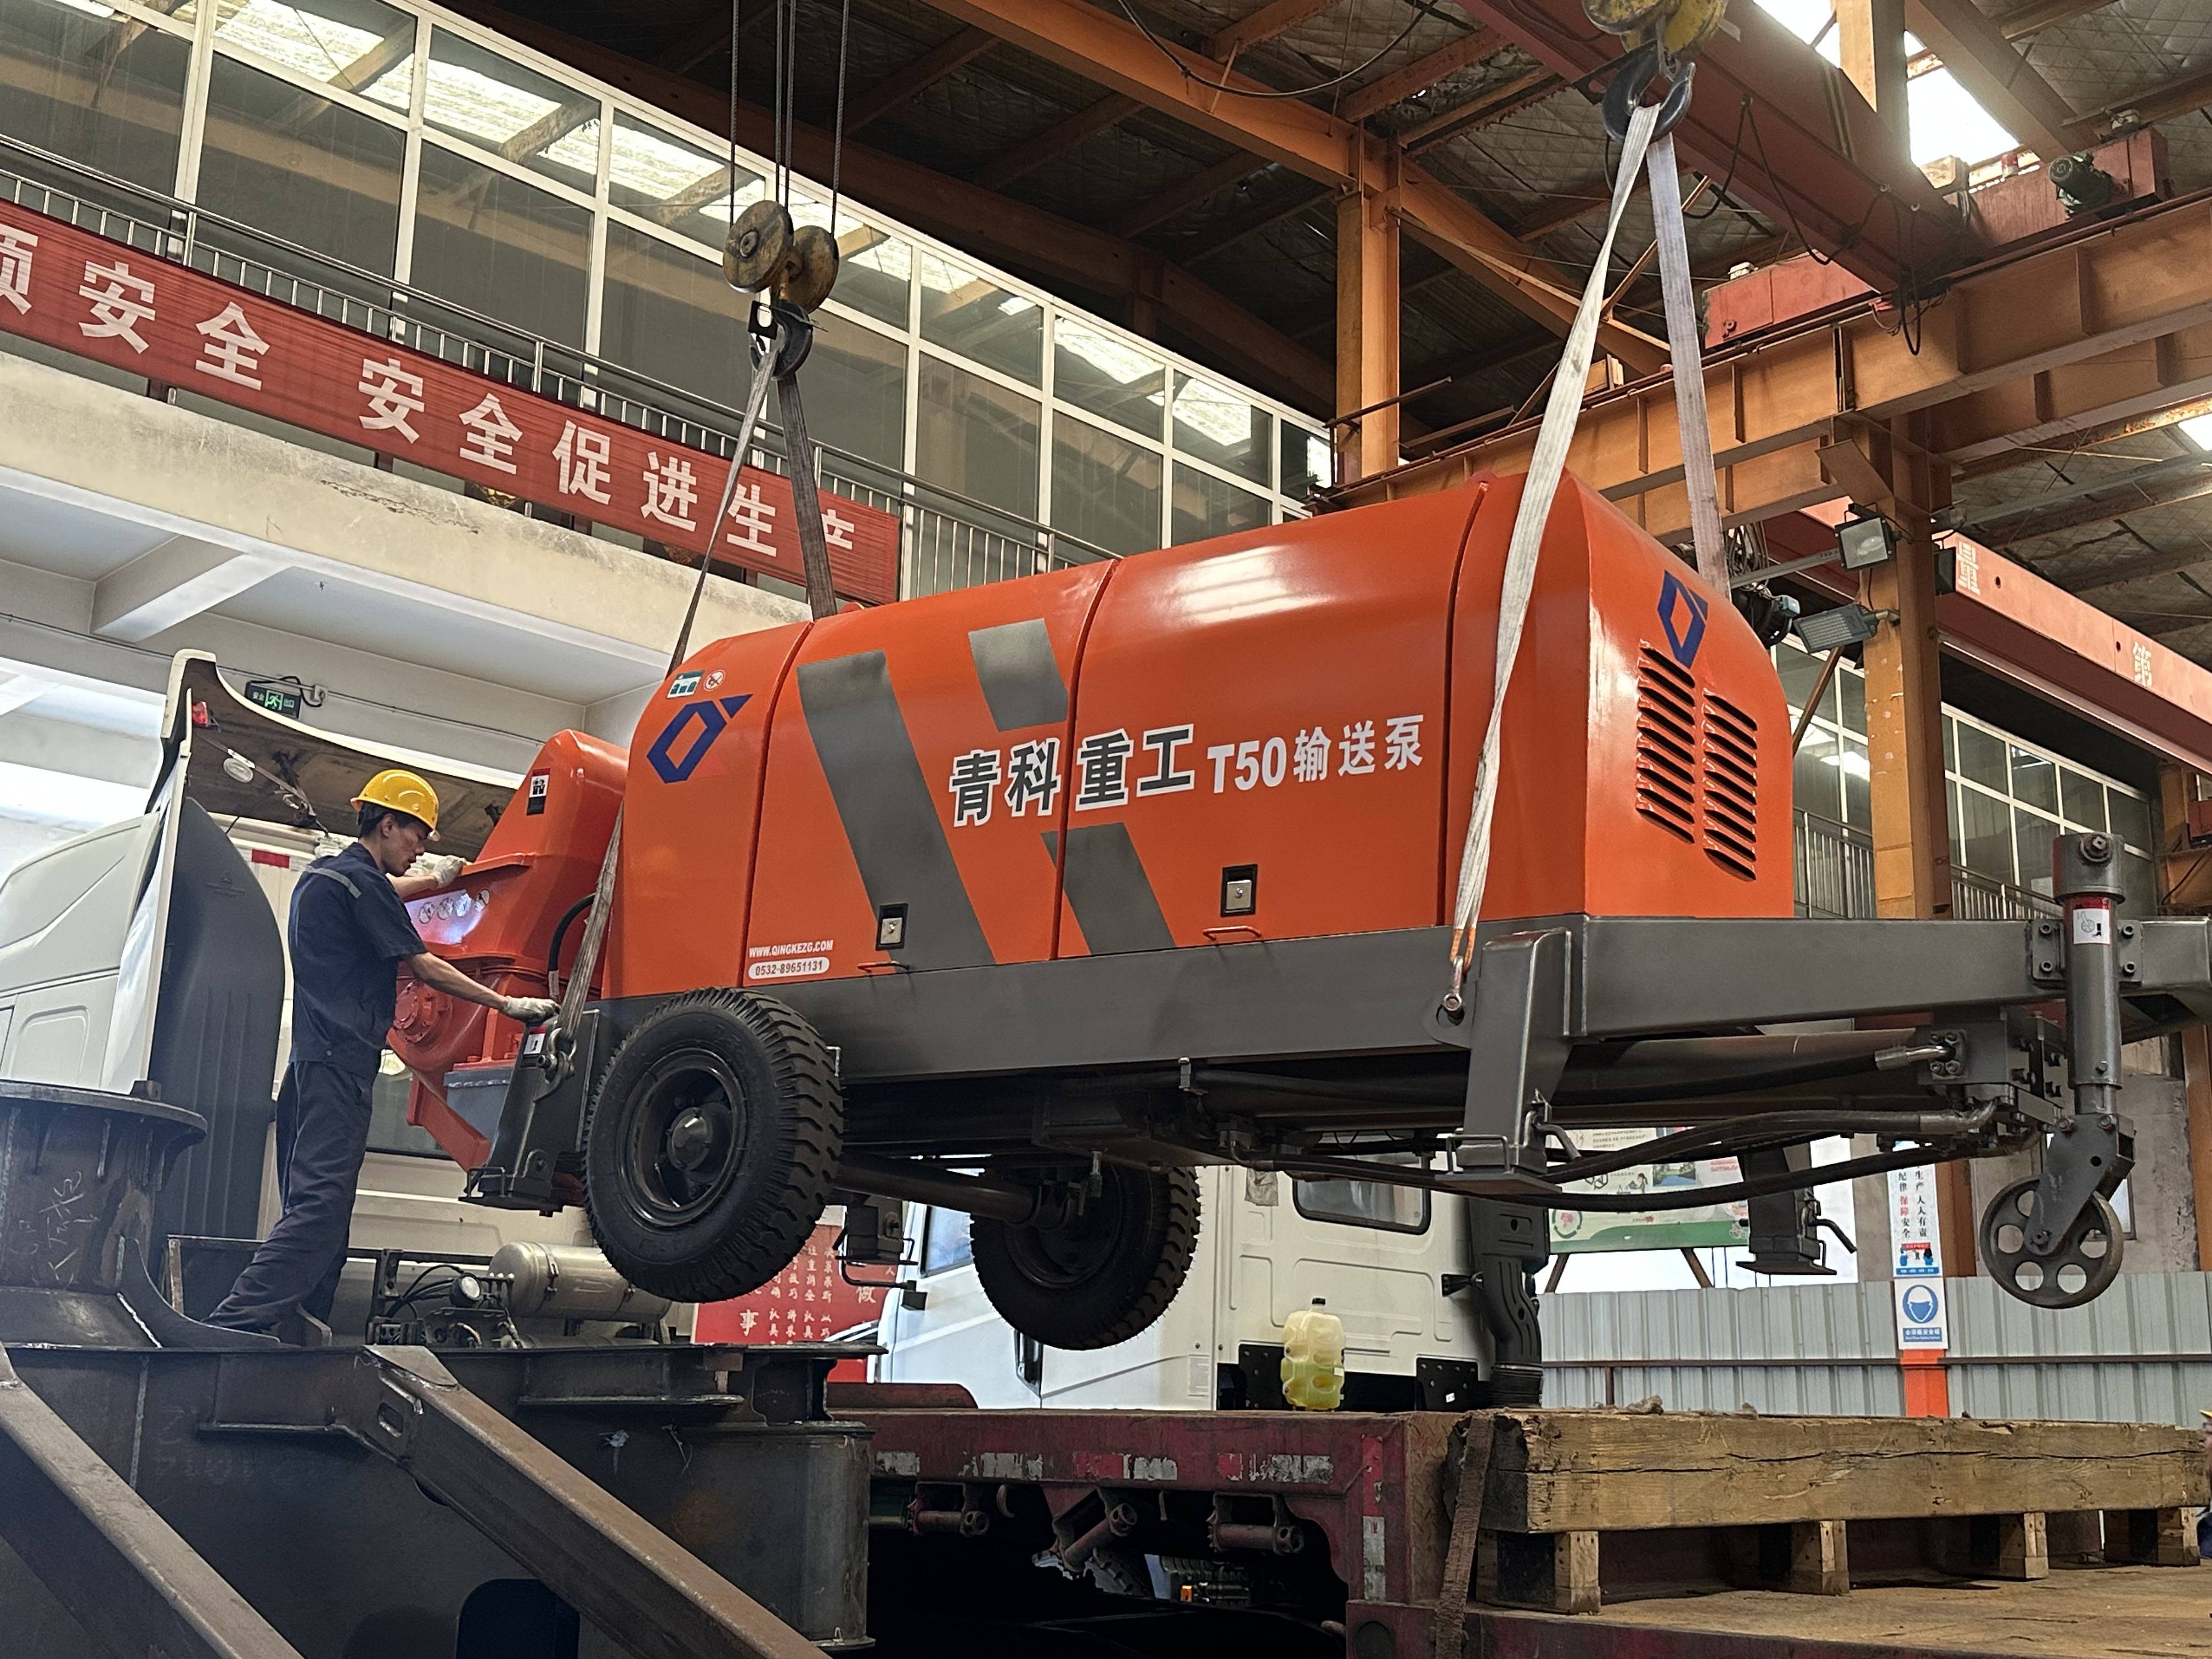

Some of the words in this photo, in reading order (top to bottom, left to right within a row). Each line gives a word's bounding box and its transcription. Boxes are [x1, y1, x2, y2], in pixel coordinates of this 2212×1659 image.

[358, 358, 855, 557] 安全促进生产
[1956, 541, 1980, 595] 量
[949, 723, 1195, 827] 青科重工
[749, 940, 833, 958] WWW.QINGKEZG.COM
[755, 960, 823, 976] 0532-89651131
[740, 1309, 759, 1336] 事
